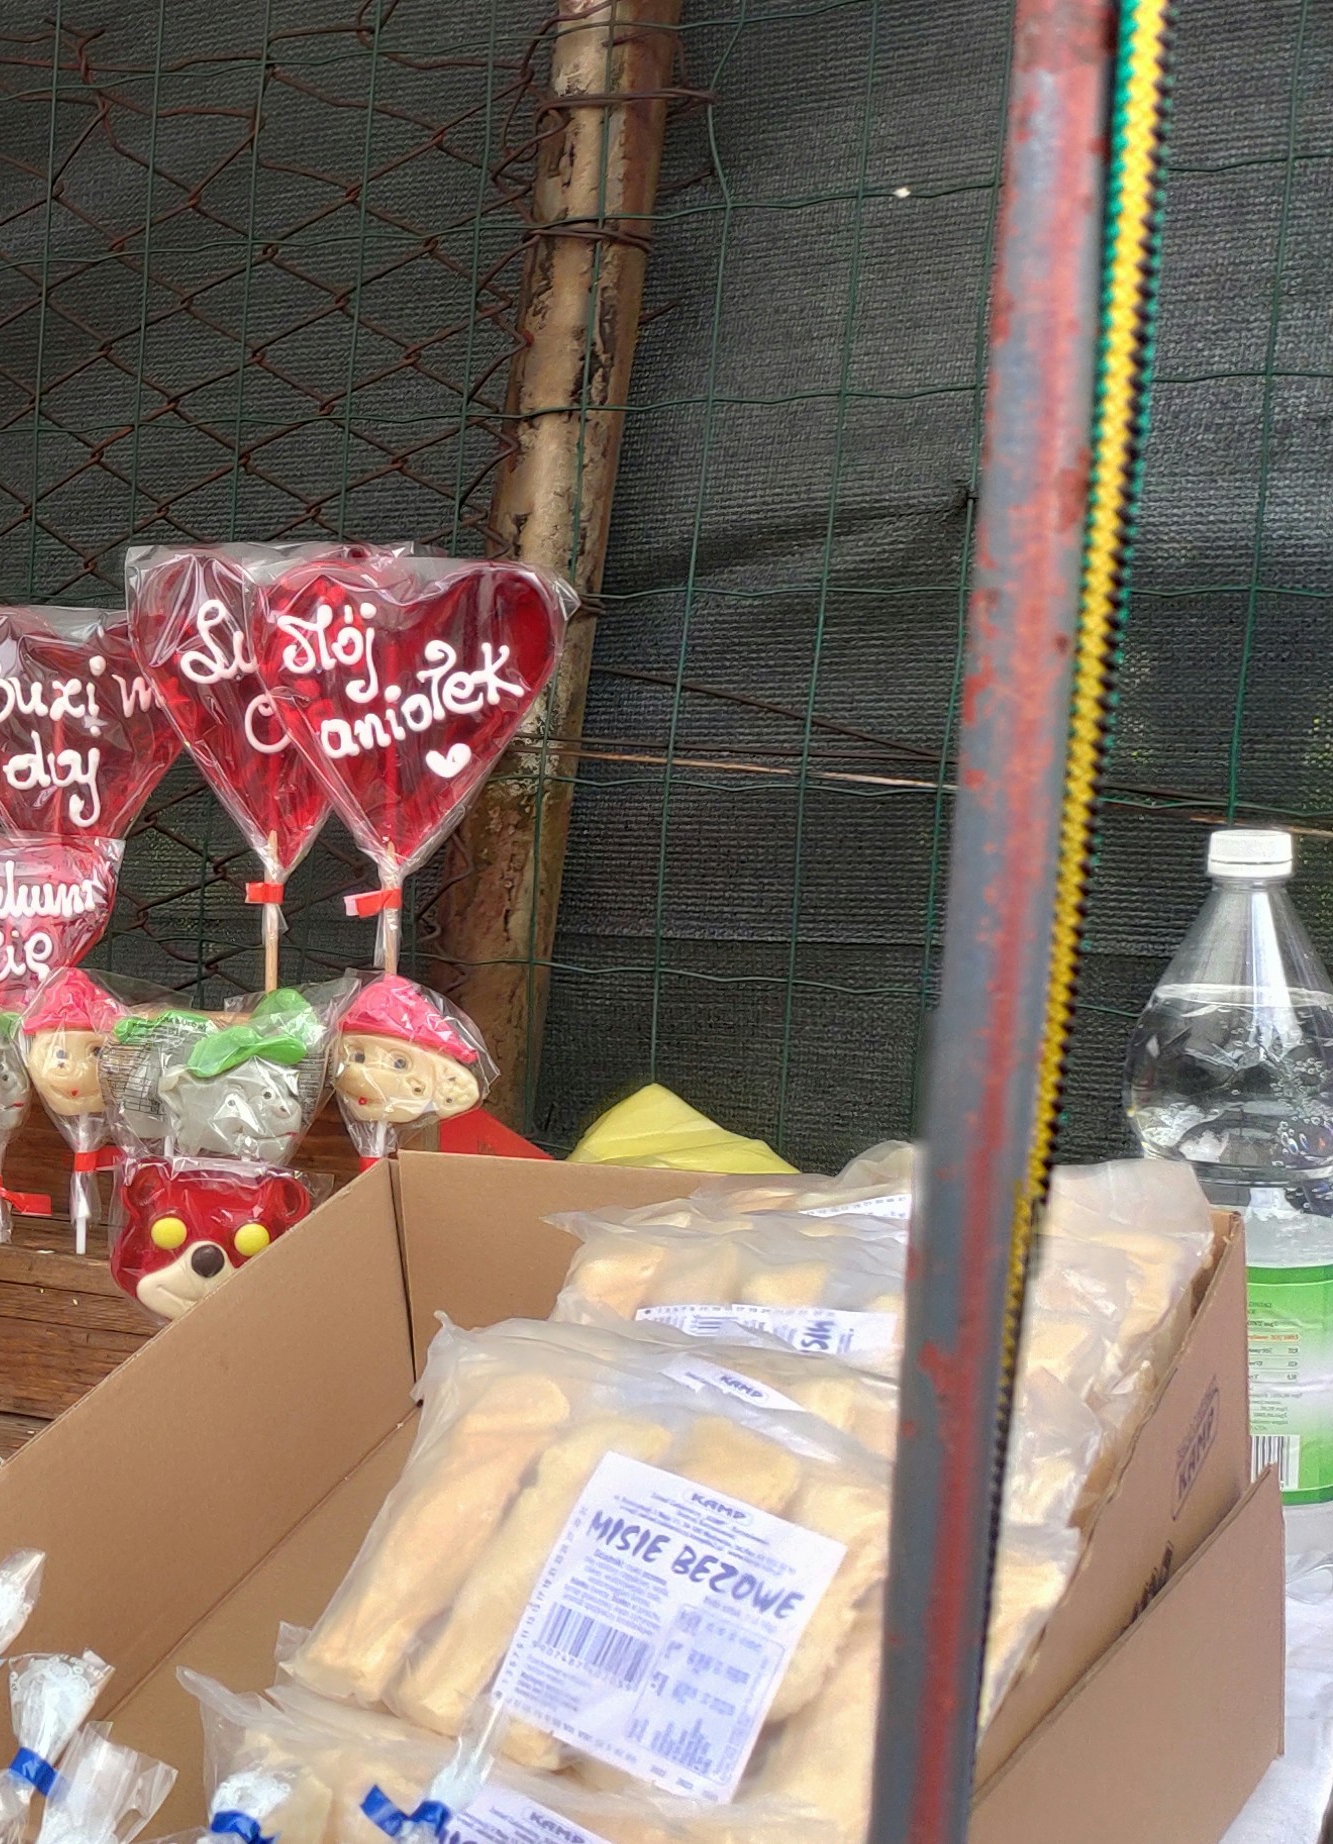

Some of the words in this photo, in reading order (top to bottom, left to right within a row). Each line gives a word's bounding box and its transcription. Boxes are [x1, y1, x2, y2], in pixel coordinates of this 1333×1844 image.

[277, 603, 379, 703] Mój
[320, 640, 524, 759] aniołek
[691, 1492, 747, 1521] KAMP
[586, 1510, 671, 1563] MISIE
[671, 1544, 805, 1620] BEZOWE
